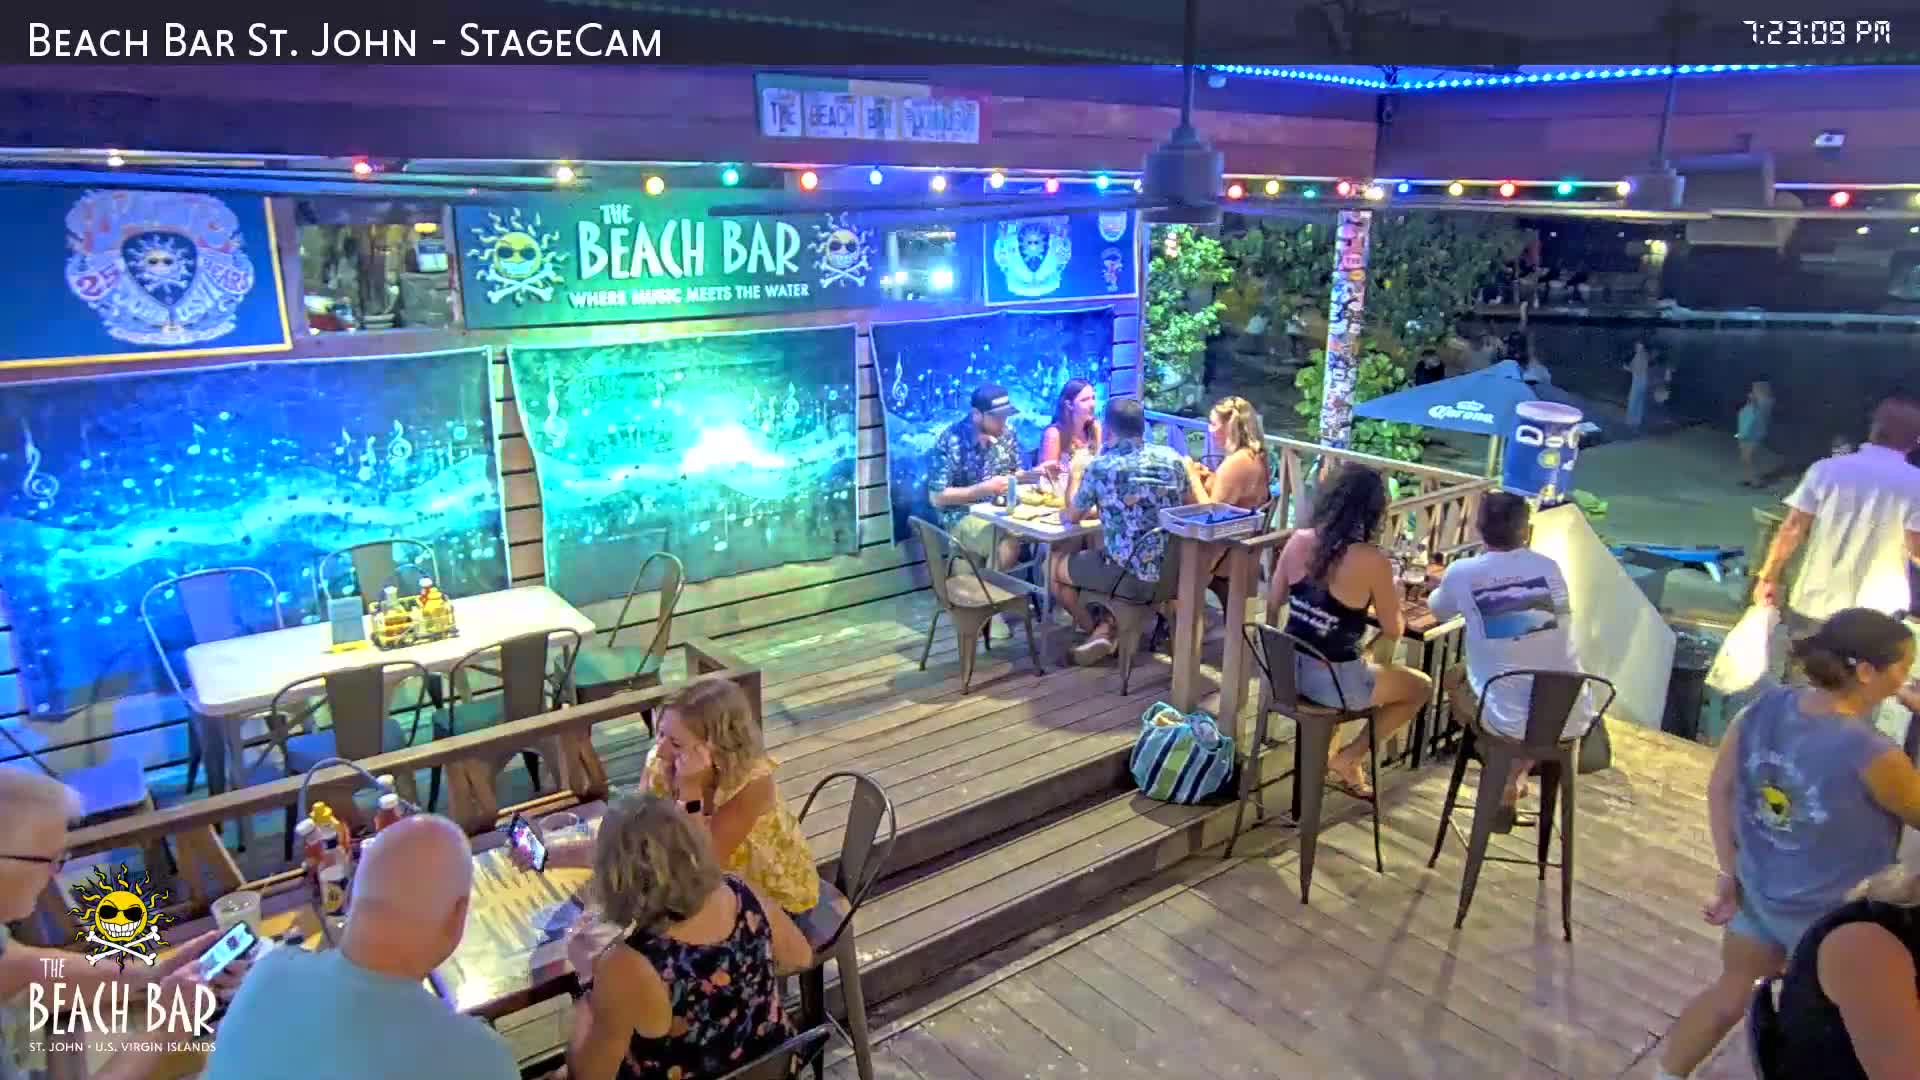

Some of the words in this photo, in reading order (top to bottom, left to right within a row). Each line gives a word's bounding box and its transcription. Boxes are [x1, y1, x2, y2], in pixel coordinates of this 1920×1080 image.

[600, 203, 633, 225] THE
[578, 218, 705, 280] BEACH
[722, 219, 801, 276] BAR
[568, 289, 626, 309] WHERE
[686, 285, 733, 305] MEETS
[735, 284, 761, 300] THE
[765, 283, 810, 299] WATER
[1428, 404, 1495, 425] Corona
